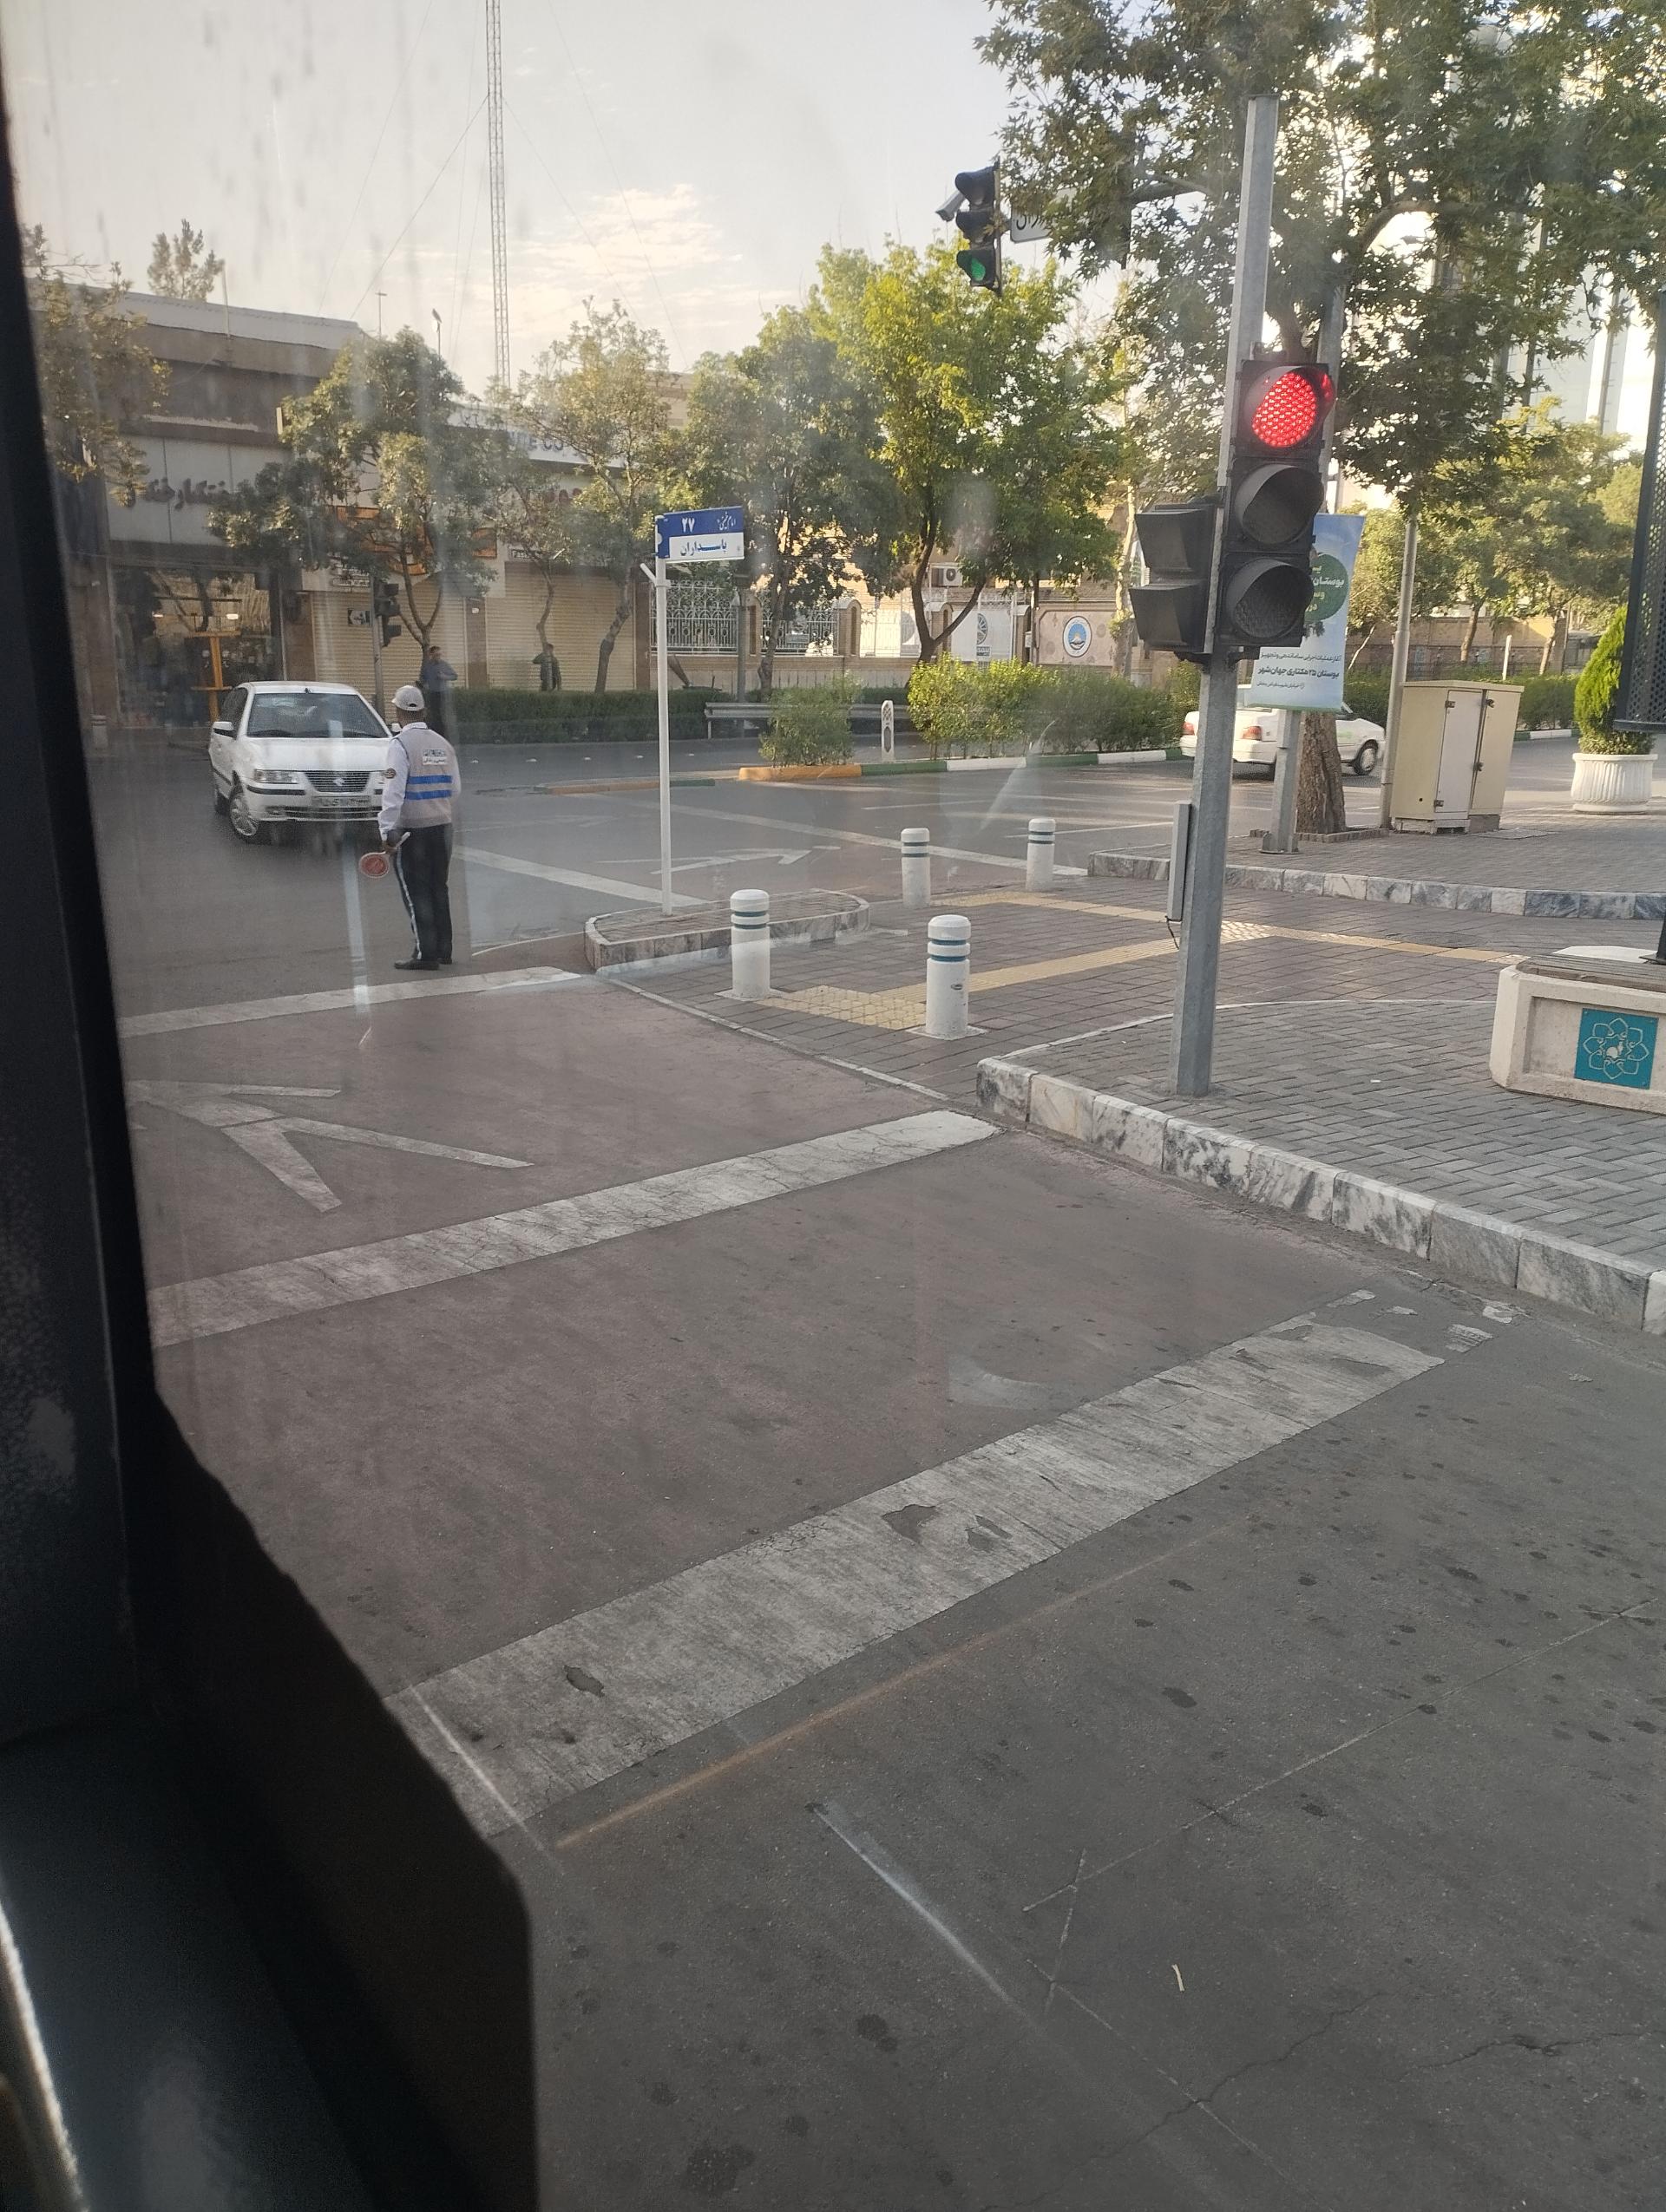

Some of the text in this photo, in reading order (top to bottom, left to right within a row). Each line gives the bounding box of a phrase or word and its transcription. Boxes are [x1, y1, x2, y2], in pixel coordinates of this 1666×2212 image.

[681, 517, 695, 533] ۲۷
[680, 539, 727, 556] پاسداران
[1317, 670, 1340, 679] بوستان
